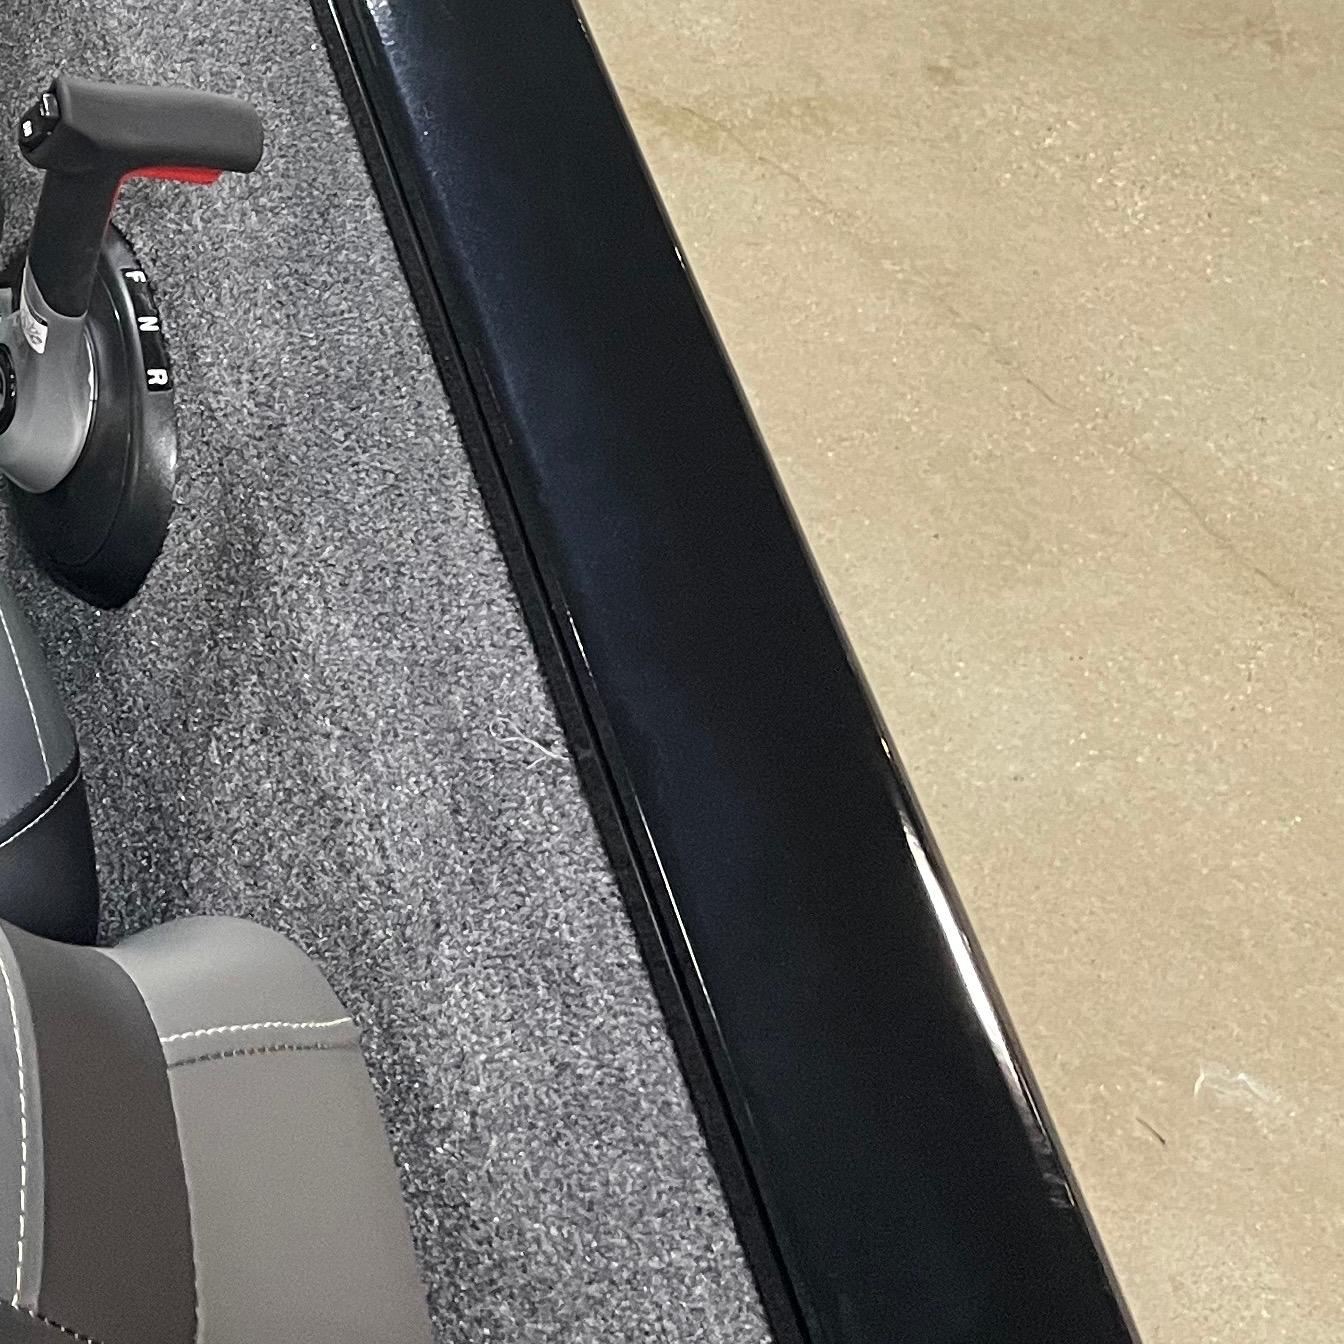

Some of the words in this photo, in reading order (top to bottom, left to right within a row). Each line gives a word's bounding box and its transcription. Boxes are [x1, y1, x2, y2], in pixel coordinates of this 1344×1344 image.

[125, 270, 147, 284] F
[138, 316, 160, 332] N
[147, 368, 169, 386] R
